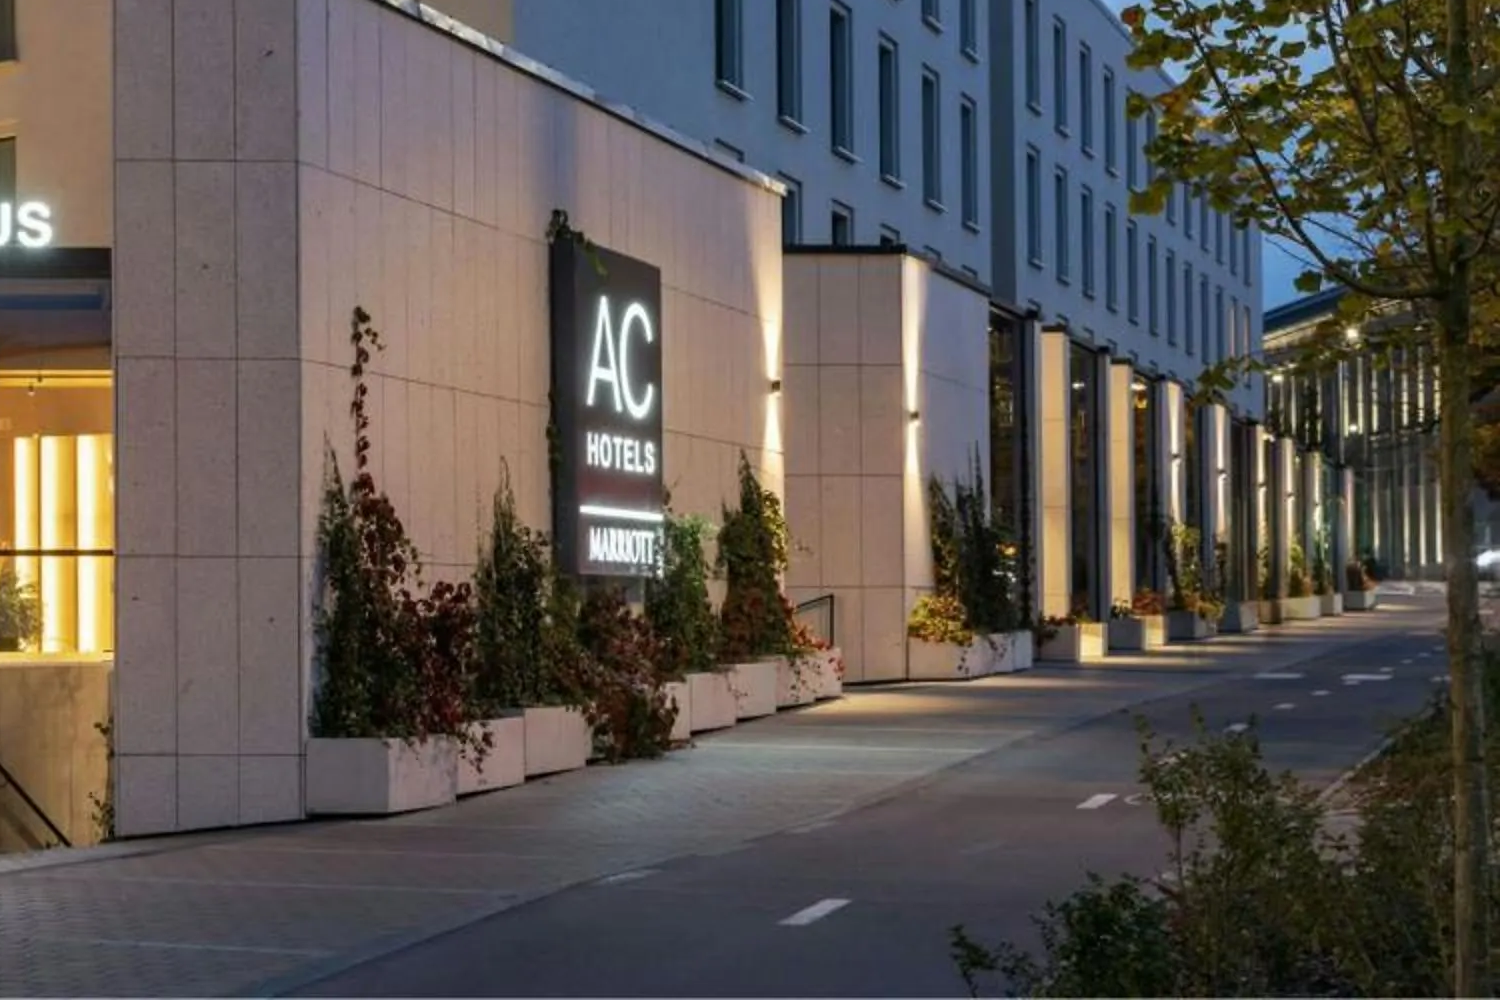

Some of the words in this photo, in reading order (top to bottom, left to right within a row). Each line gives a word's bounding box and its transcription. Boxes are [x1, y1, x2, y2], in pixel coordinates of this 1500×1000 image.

[585, 294, 654, 419] AC
[586, 431, 656, 475] HOTELS
[588, 527, 654, 565] MARRIOTT
